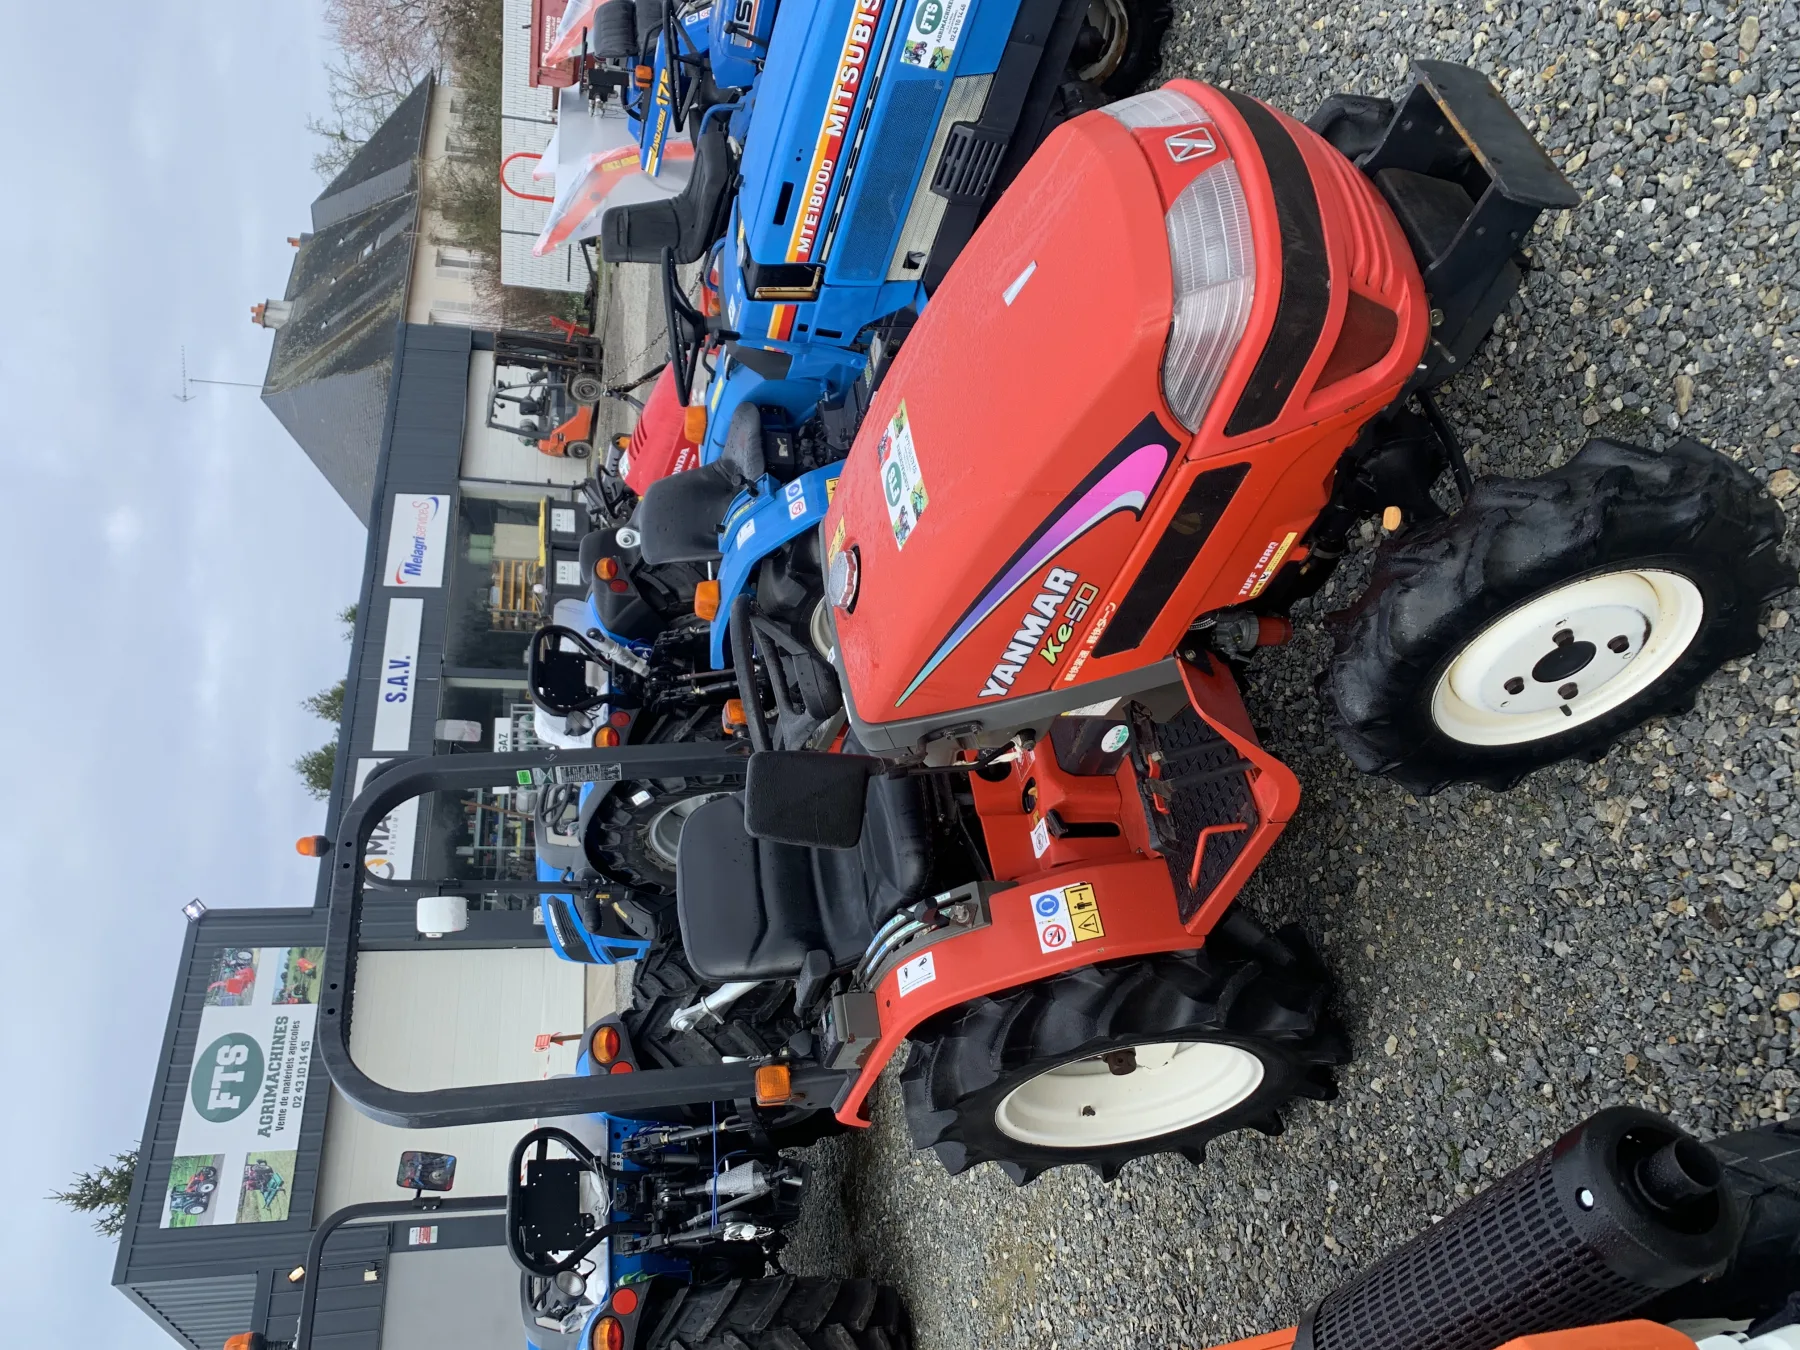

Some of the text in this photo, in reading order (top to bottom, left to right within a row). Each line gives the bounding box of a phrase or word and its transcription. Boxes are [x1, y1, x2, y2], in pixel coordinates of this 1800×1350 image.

[920, 2, 938, 30] FTS
[936, 0, 954, 43] AGRIMACHINE
[950, 34, 956, 42] 02
[796, 159, 834, 253] MTE1800D
[671, 447, 690, 475] NDA
[888, 467, 900, 502] FTS
[403, 501, 430, 576] MelagriserviceS
[1238, 572, 1258, 596] TUFF
[1254, 541, 1280, 570] TORQ
[977, 567, 1080, 698] YANMAR
[1038, 582, 1100, 666] Ke-50
[385, 655, 411, 703] S.A.V.
[388, 817, 398, 856] PREMIUM
[207, 1044, 249, 1110] FTS
[257, 1015, 289, 1138] AGRIMACHINES
[275, 1020, 301, 1131] Vente de matériels agricoles
[292, 1040, 310, 1108] 02 43 10 14 45
